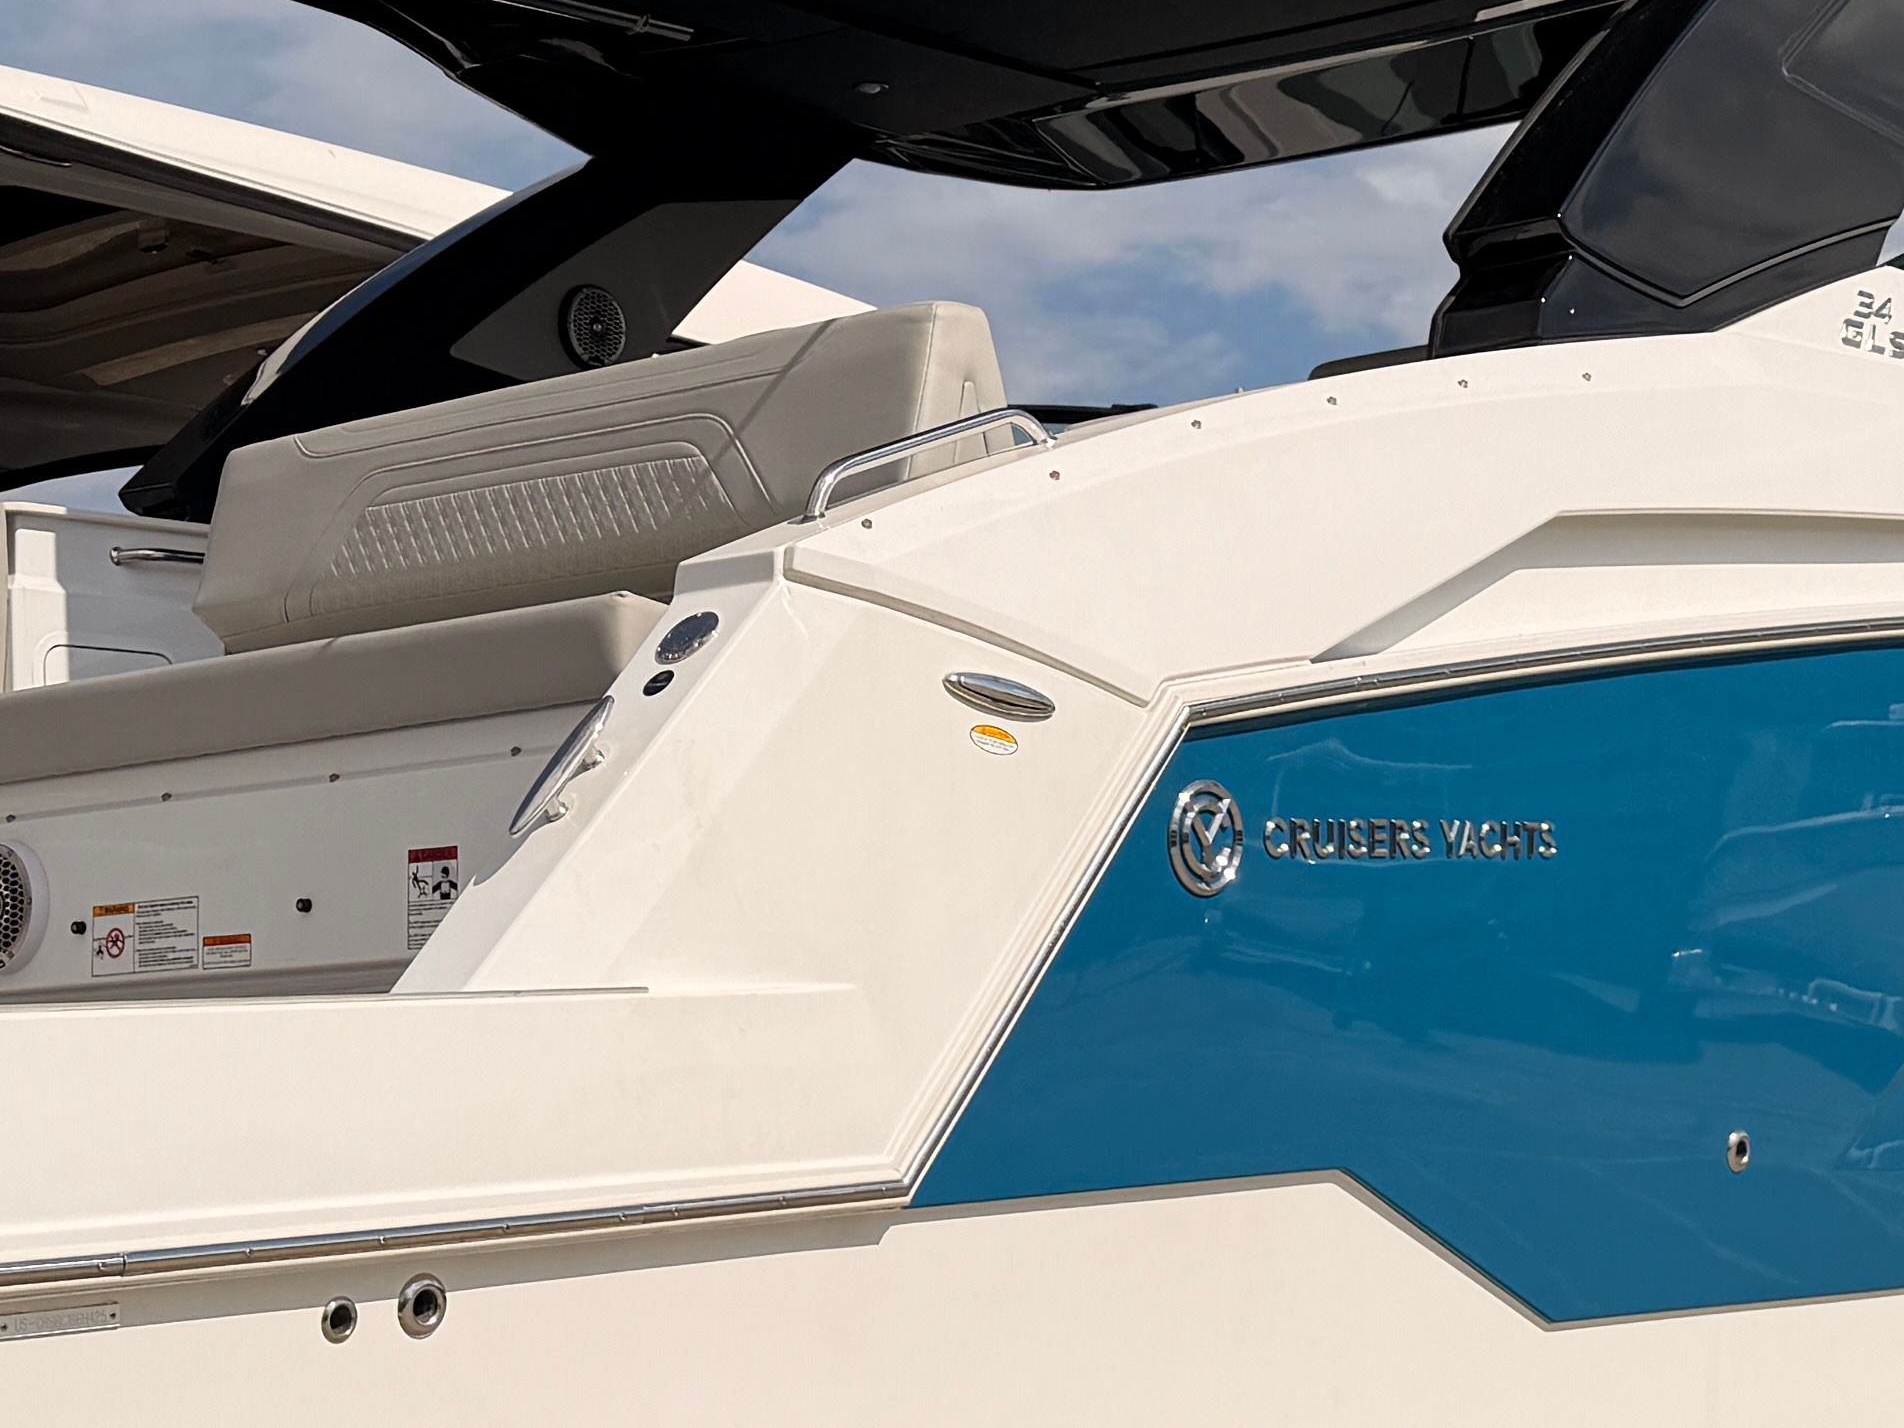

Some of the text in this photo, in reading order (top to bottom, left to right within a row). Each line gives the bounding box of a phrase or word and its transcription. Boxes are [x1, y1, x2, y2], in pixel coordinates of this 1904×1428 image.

[1853, 290, 1893, 324] 34
[1263, 817, 1558, 860] CRUISERS YACHTS
